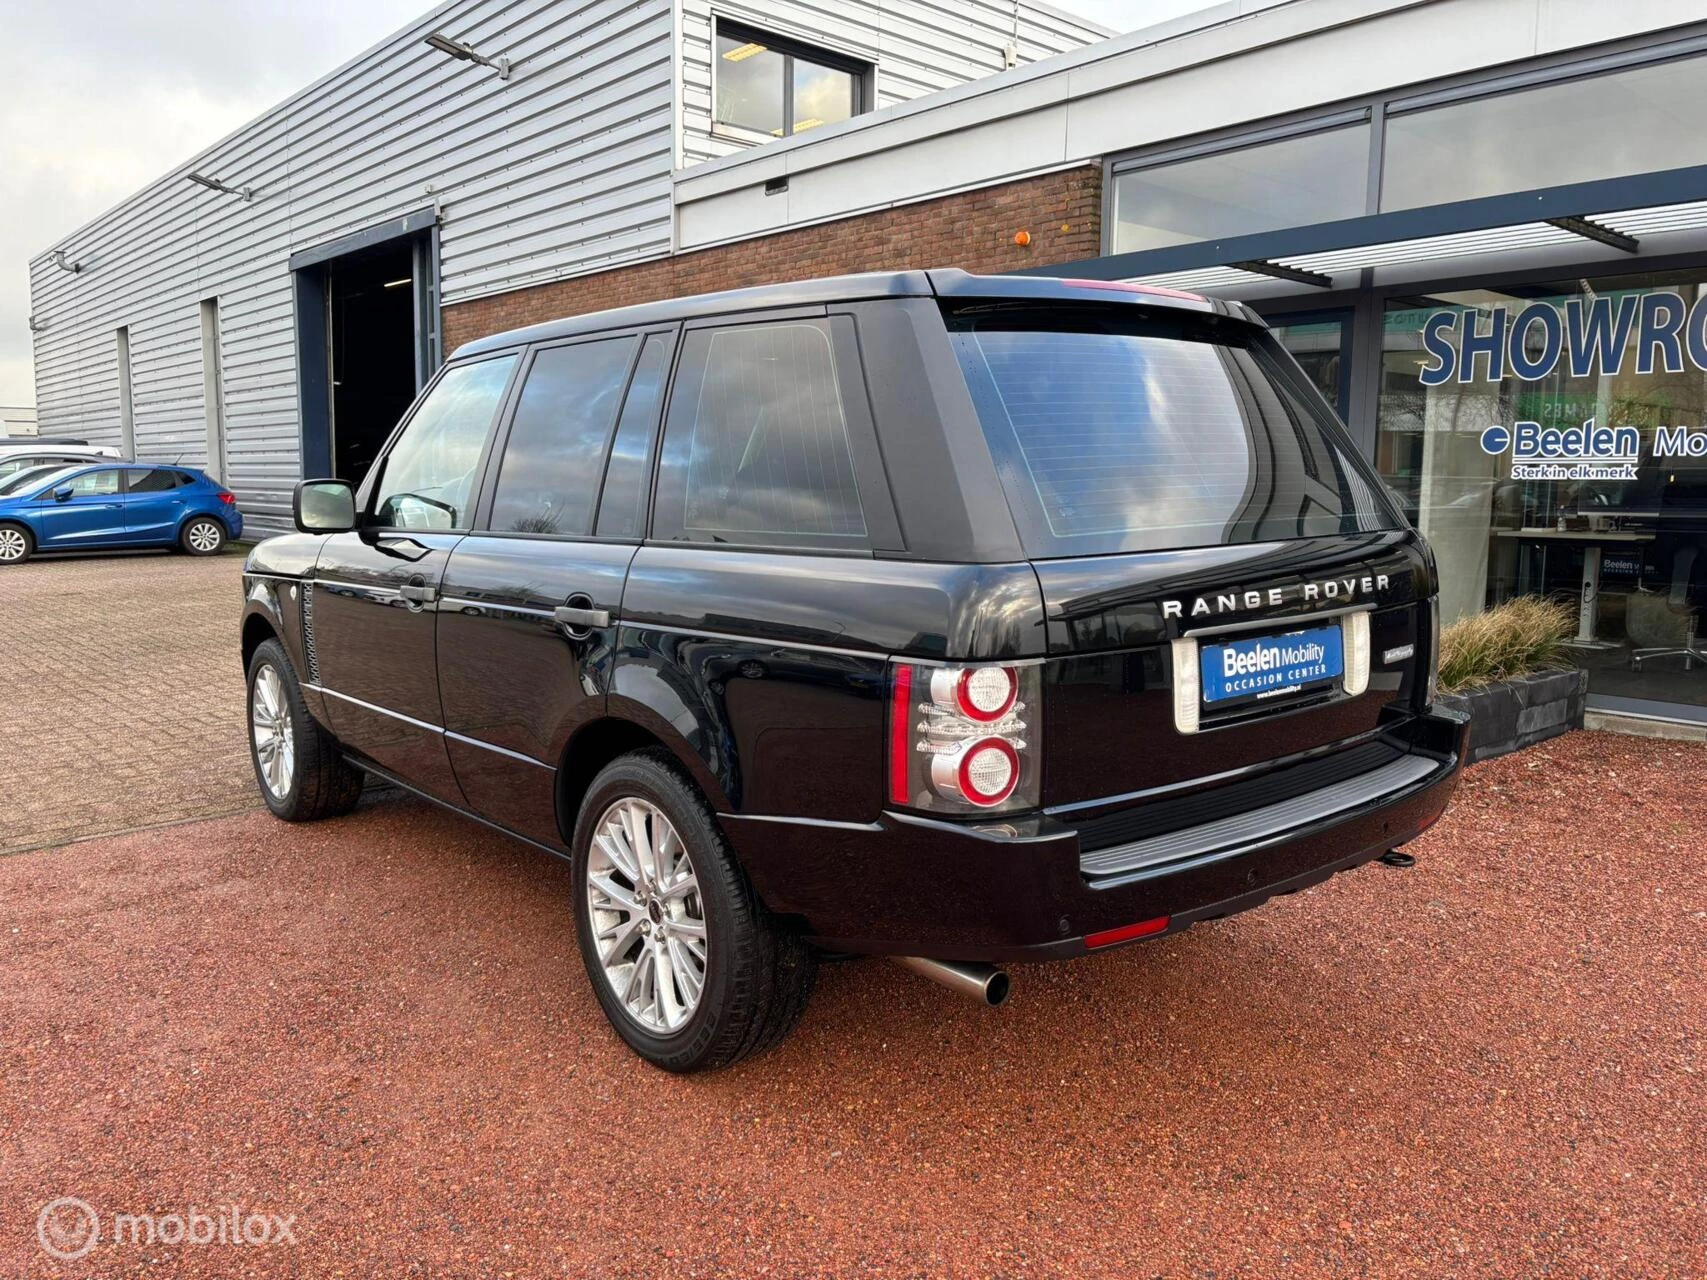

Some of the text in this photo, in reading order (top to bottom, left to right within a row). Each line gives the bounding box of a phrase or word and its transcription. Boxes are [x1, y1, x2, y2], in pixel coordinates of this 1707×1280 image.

[1513, 417, 1707, 458] Beelen Mo
[1511, 463, 1636, 479] Sterk in elk merk
[1162, 574, 1390, 619] RANGE ROVER
[1223, 643, 1325, 677] Beelen Mobility
[1225, 664, 1326, 693] OCCASION CENTER
